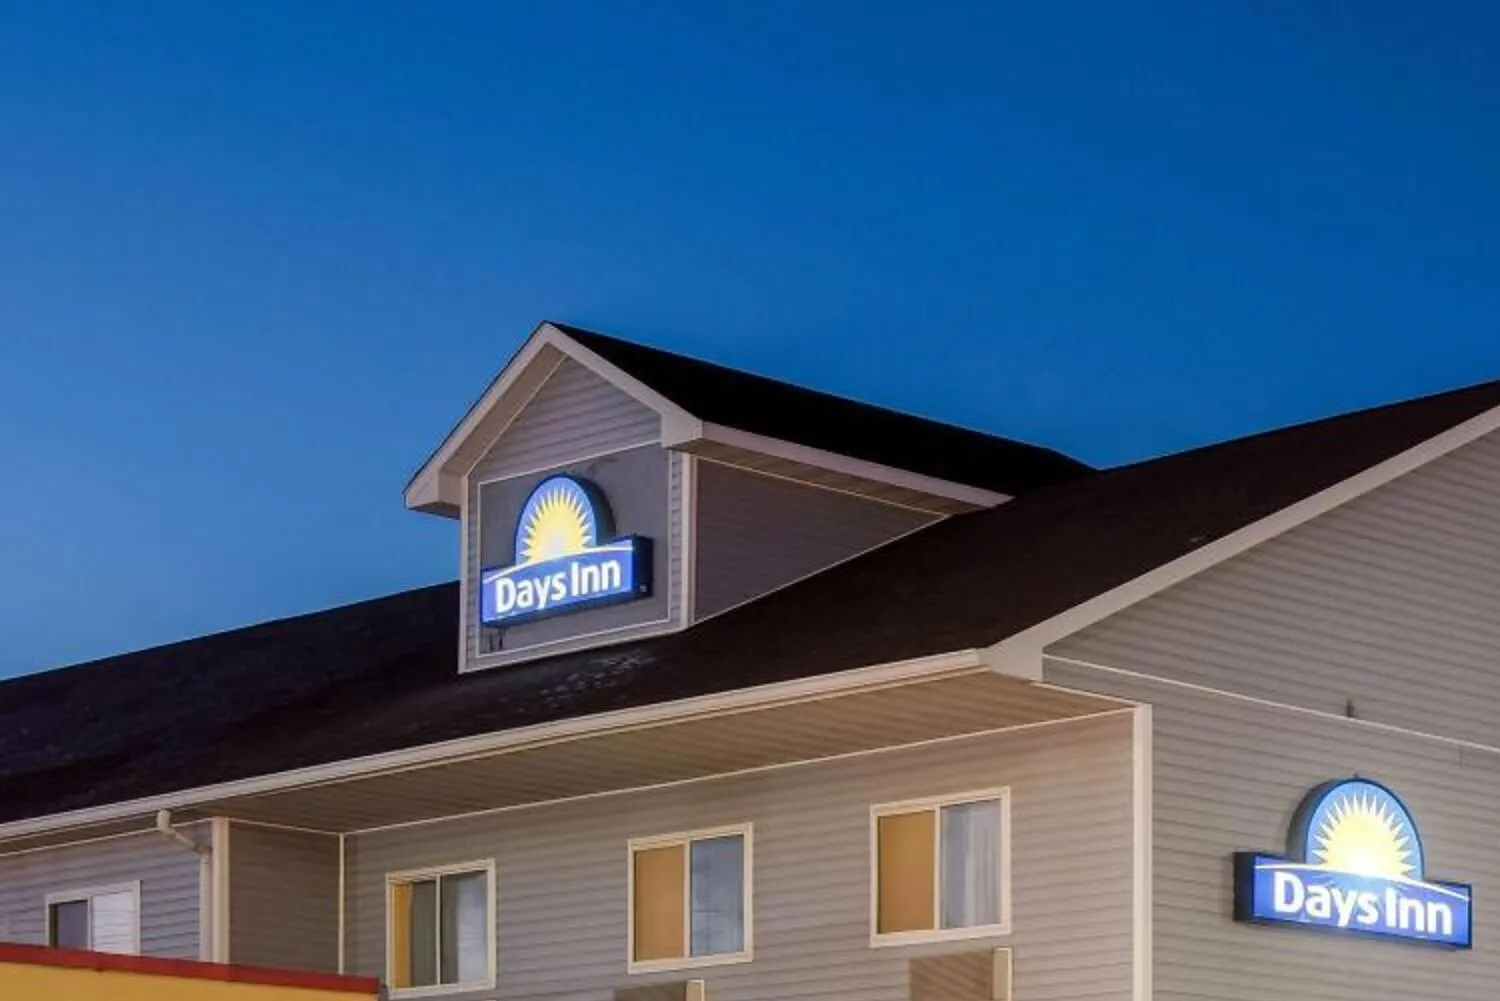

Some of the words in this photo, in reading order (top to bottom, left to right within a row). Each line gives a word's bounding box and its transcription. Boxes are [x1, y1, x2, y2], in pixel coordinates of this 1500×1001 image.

[495, 571, 568, 613] Days
[570, 559, 620, 597] Inn
[1273, 870, 1380, 928] Days
[1385, 886, 1453, 935] Inn
